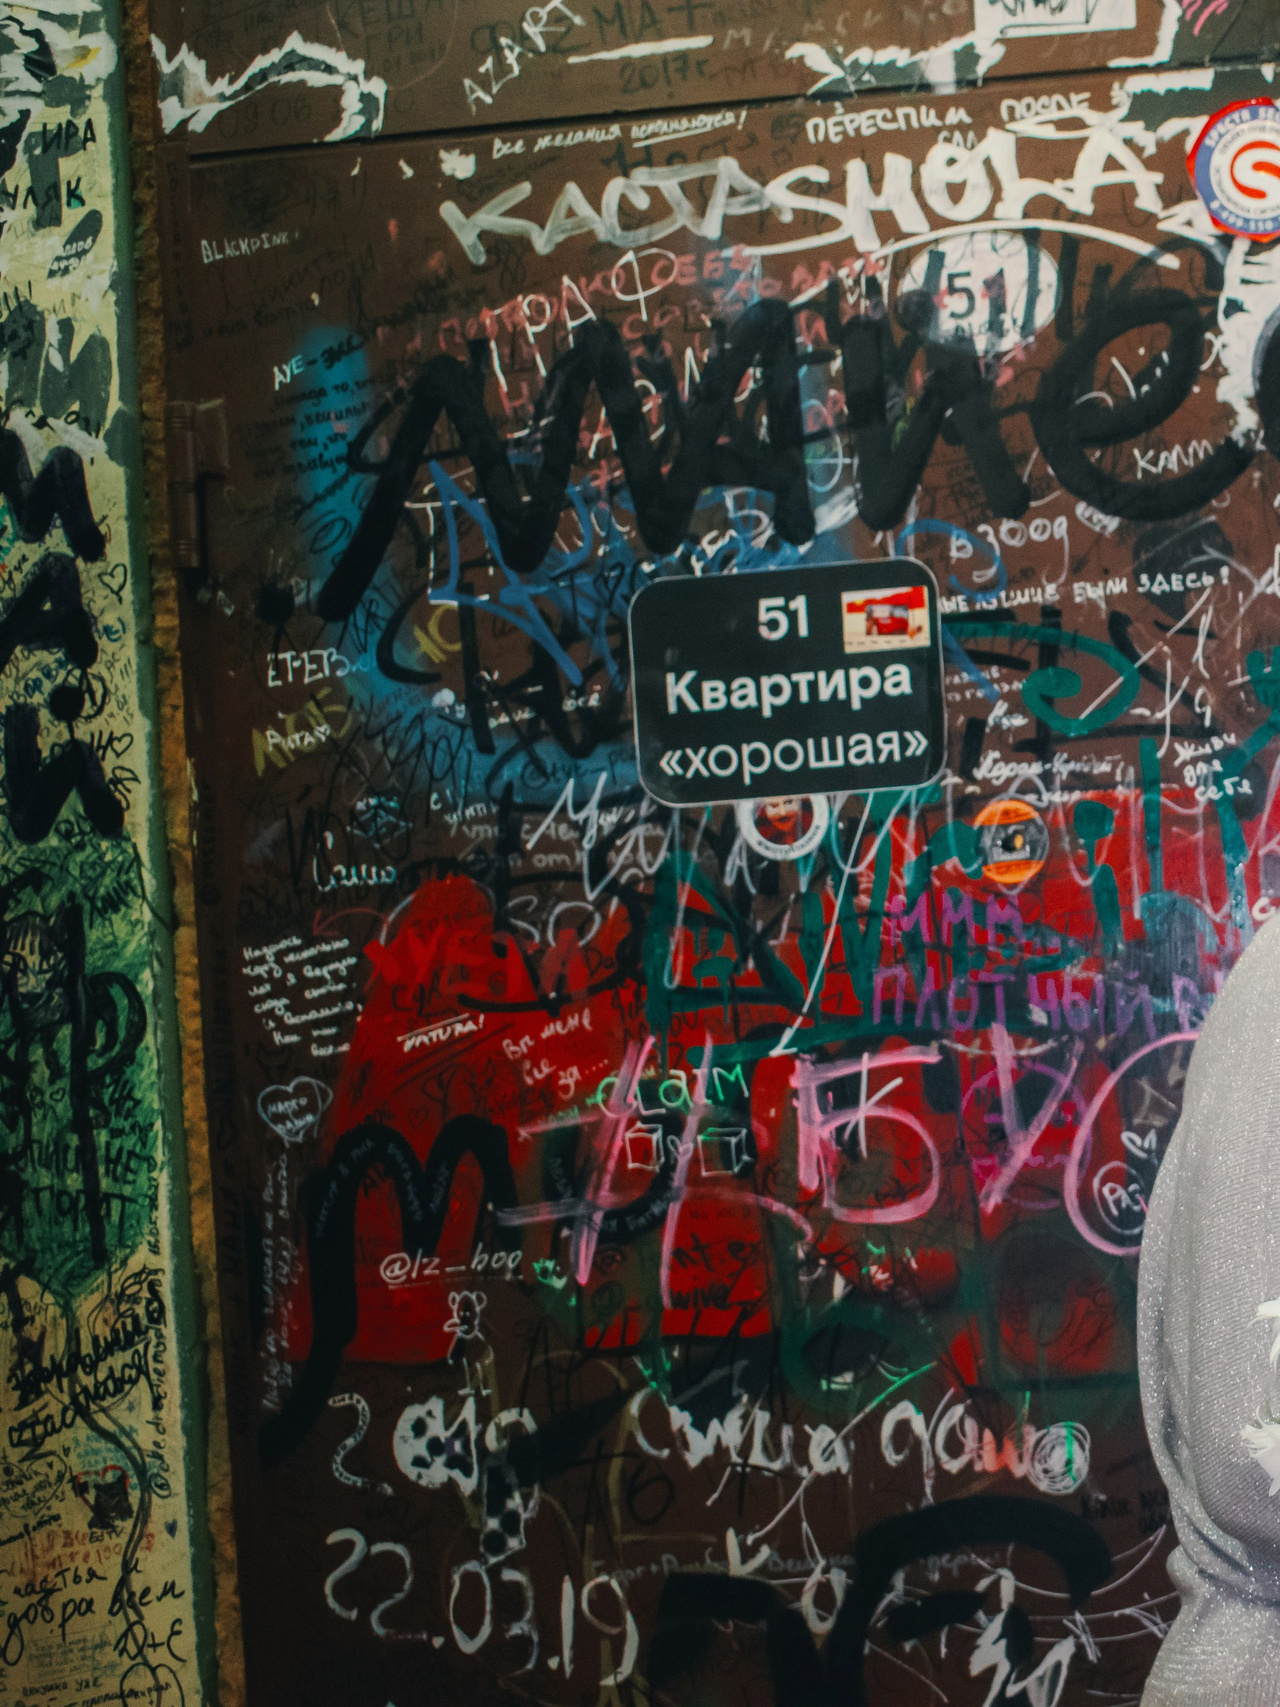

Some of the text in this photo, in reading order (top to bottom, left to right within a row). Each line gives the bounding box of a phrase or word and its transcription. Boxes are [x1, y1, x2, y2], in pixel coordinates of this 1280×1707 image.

[756, 594, 814, 643] 51
[665, 663, 914, 719] Квартира
[659, 729, 930, 786] «хорошая»
